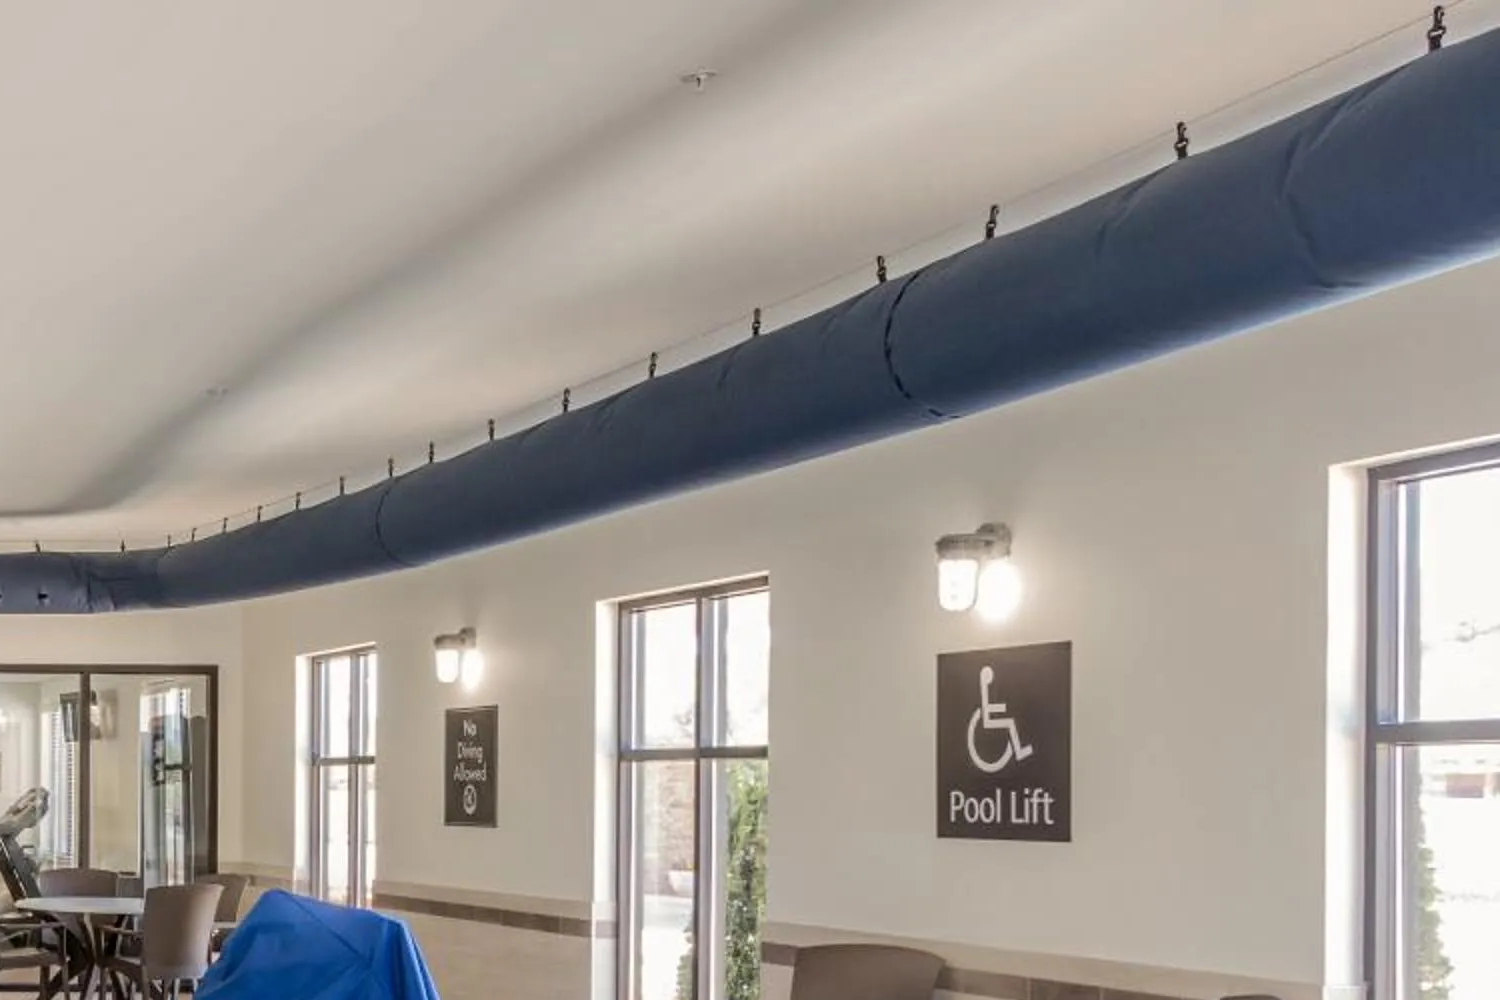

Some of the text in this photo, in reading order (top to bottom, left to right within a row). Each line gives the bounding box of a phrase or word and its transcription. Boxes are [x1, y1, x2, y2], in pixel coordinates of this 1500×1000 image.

[463, 719, 477, 737] No
[950, 787, 1055, 825] Pool Lift
